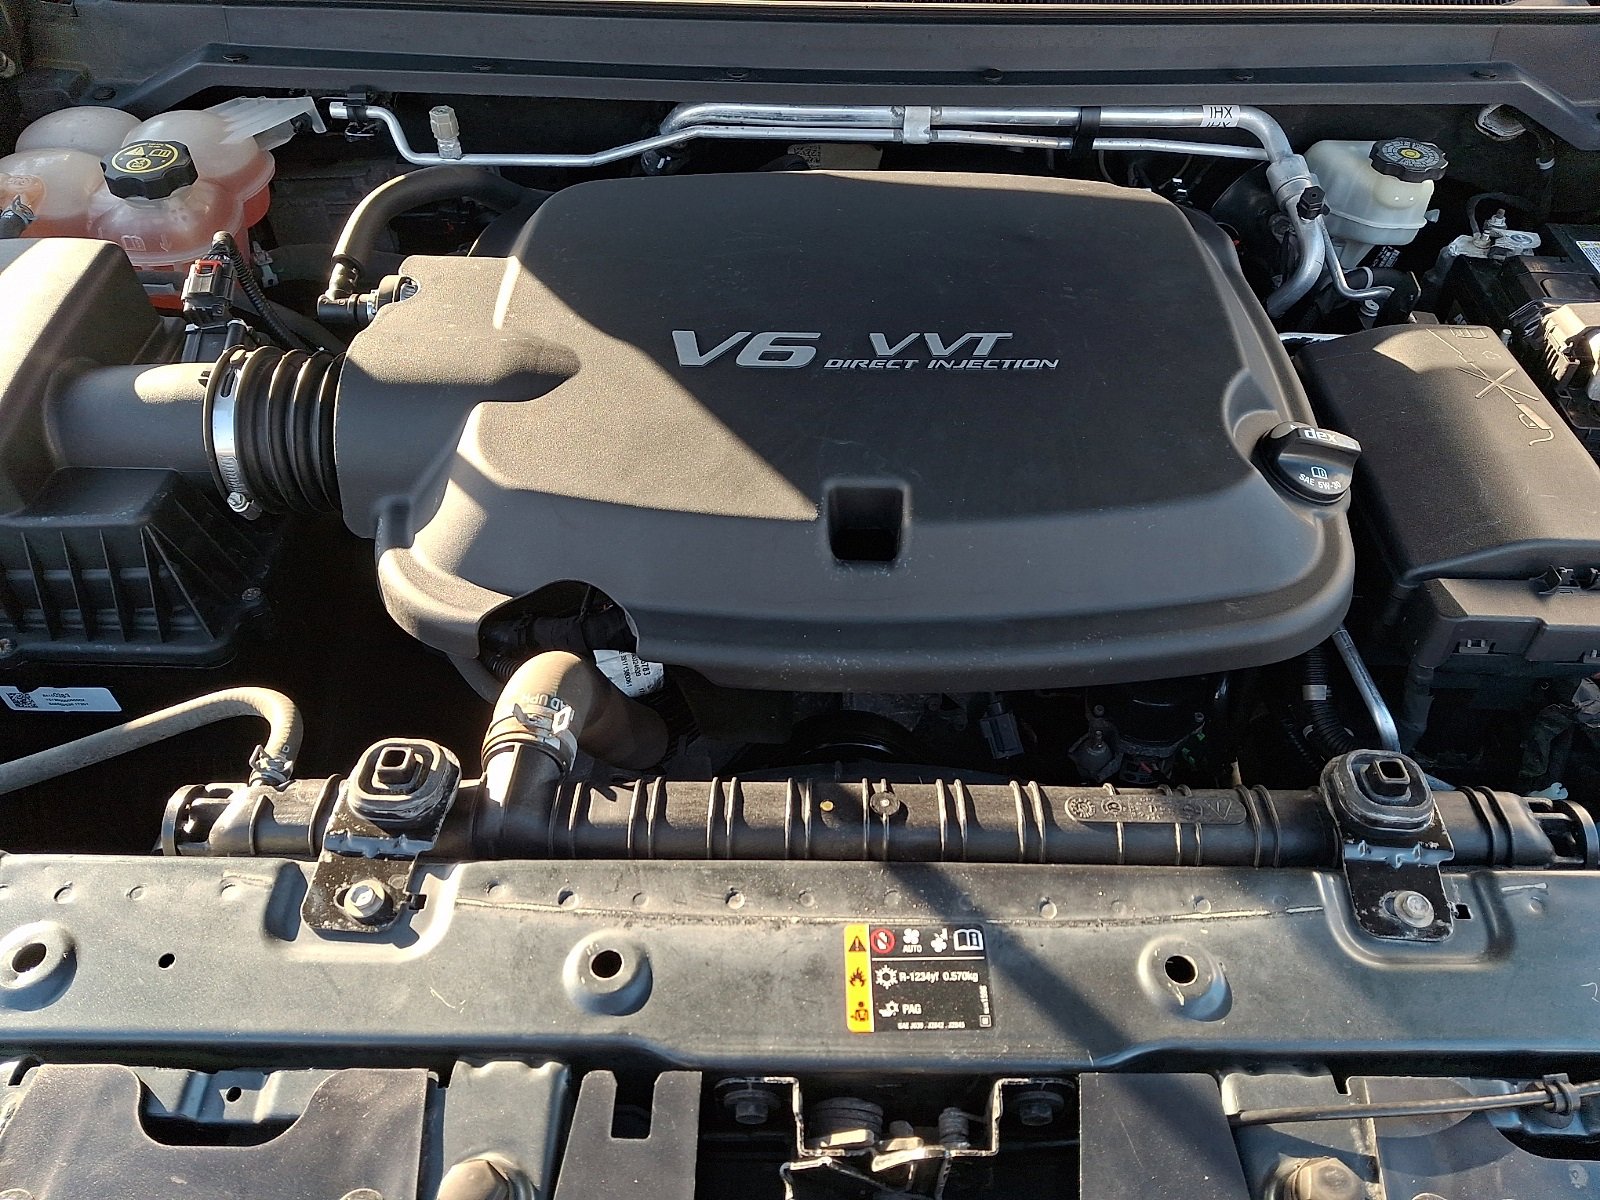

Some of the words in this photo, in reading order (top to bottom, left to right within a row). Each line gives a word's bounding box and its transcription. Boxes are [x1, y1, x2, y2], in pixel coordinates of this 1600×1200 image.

[1210, 106, 1233, 119] IHX
[672, 330, 822, 369] V6
[869, 332, 1014, 358] VVT
[823, 358, 920, 370] DIRECT
[927, 358, 1060, 370] INJECTION
[1298, 473, 1315, 487] SAE
[902, 944, 923, 954] AUTO
[898, 971, 939, 984] R-1234yf
[942, 970, 979, 983] 0.570kg
[901, 1003, 922, 1015] PAG
